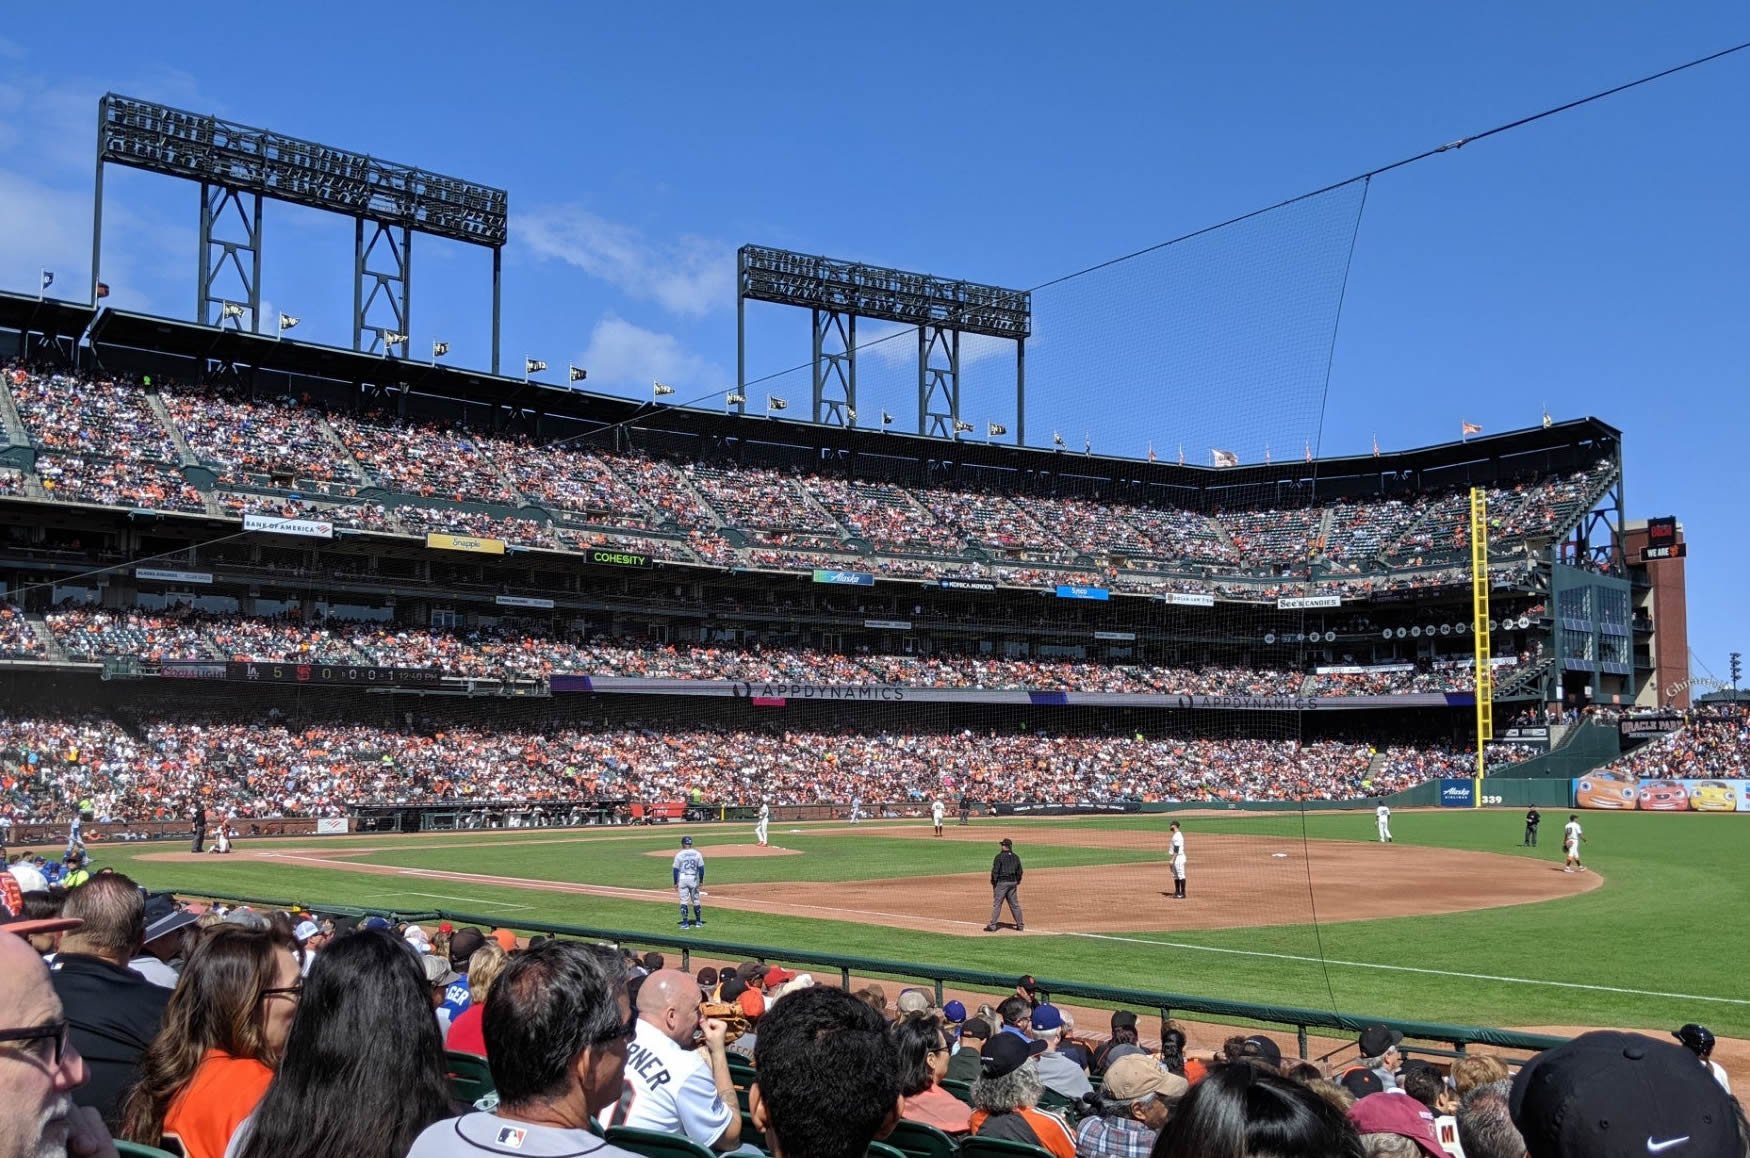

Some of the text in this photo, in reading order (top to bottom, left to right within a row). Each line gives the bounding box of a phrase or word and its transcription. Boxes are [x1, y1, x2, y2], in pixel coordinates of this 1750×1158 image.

[280, 525, 315, 533] AMERICA
[594, 552, 646, 566] COHESITY
[1647, 549, 1657, 558] WE
[1658, 547, 1669, 557] ARE
[831, 573, 860, 583] Alaska
[1305, 599, 1337, 607] CANDIES
[273, 666, 282, 678] 5
[322, 668, 332, 679] 0
[349, 669, 357, 680] 0
[368, 669, 376, 680] 0
[399, 672, 422, 681] 12:40
[424, 673, 438, 681] PM
[762, 684, 904, 700] APPDYNAMICS
[1202, 696, 1318, 709] APPDYNAMICS
[1621, 720, 1657, 734] ORACLE
[1443, 787, 1470, 796] Alaska
[1482, 795, 1502, 804] 339
[445, 986, 469, 1006] GER
[1441, 1124, 1455, 1143] M
